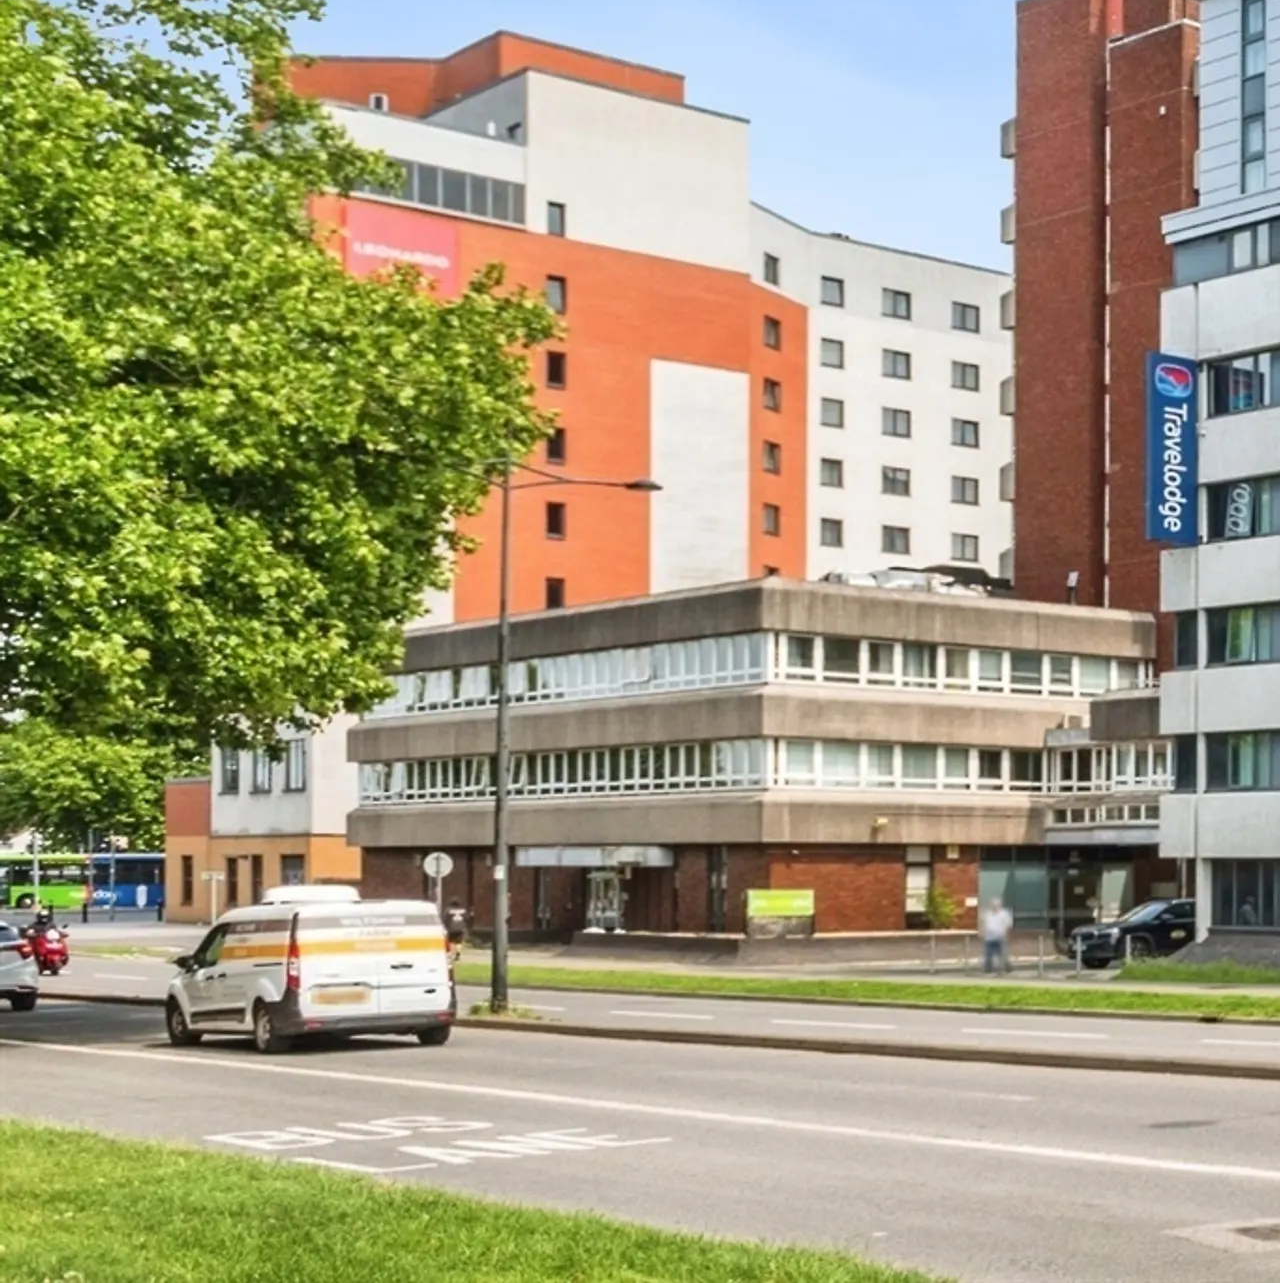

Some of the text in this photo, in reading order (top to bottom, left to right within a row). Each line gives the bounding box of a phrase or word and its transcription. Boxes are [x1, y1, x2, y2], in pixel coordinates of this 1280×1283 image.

[1159, 403, 1188, 533] Travelodge
[203, 1115, 494, 1151] BUS
[291, 1128, 673, 1174] LANE
